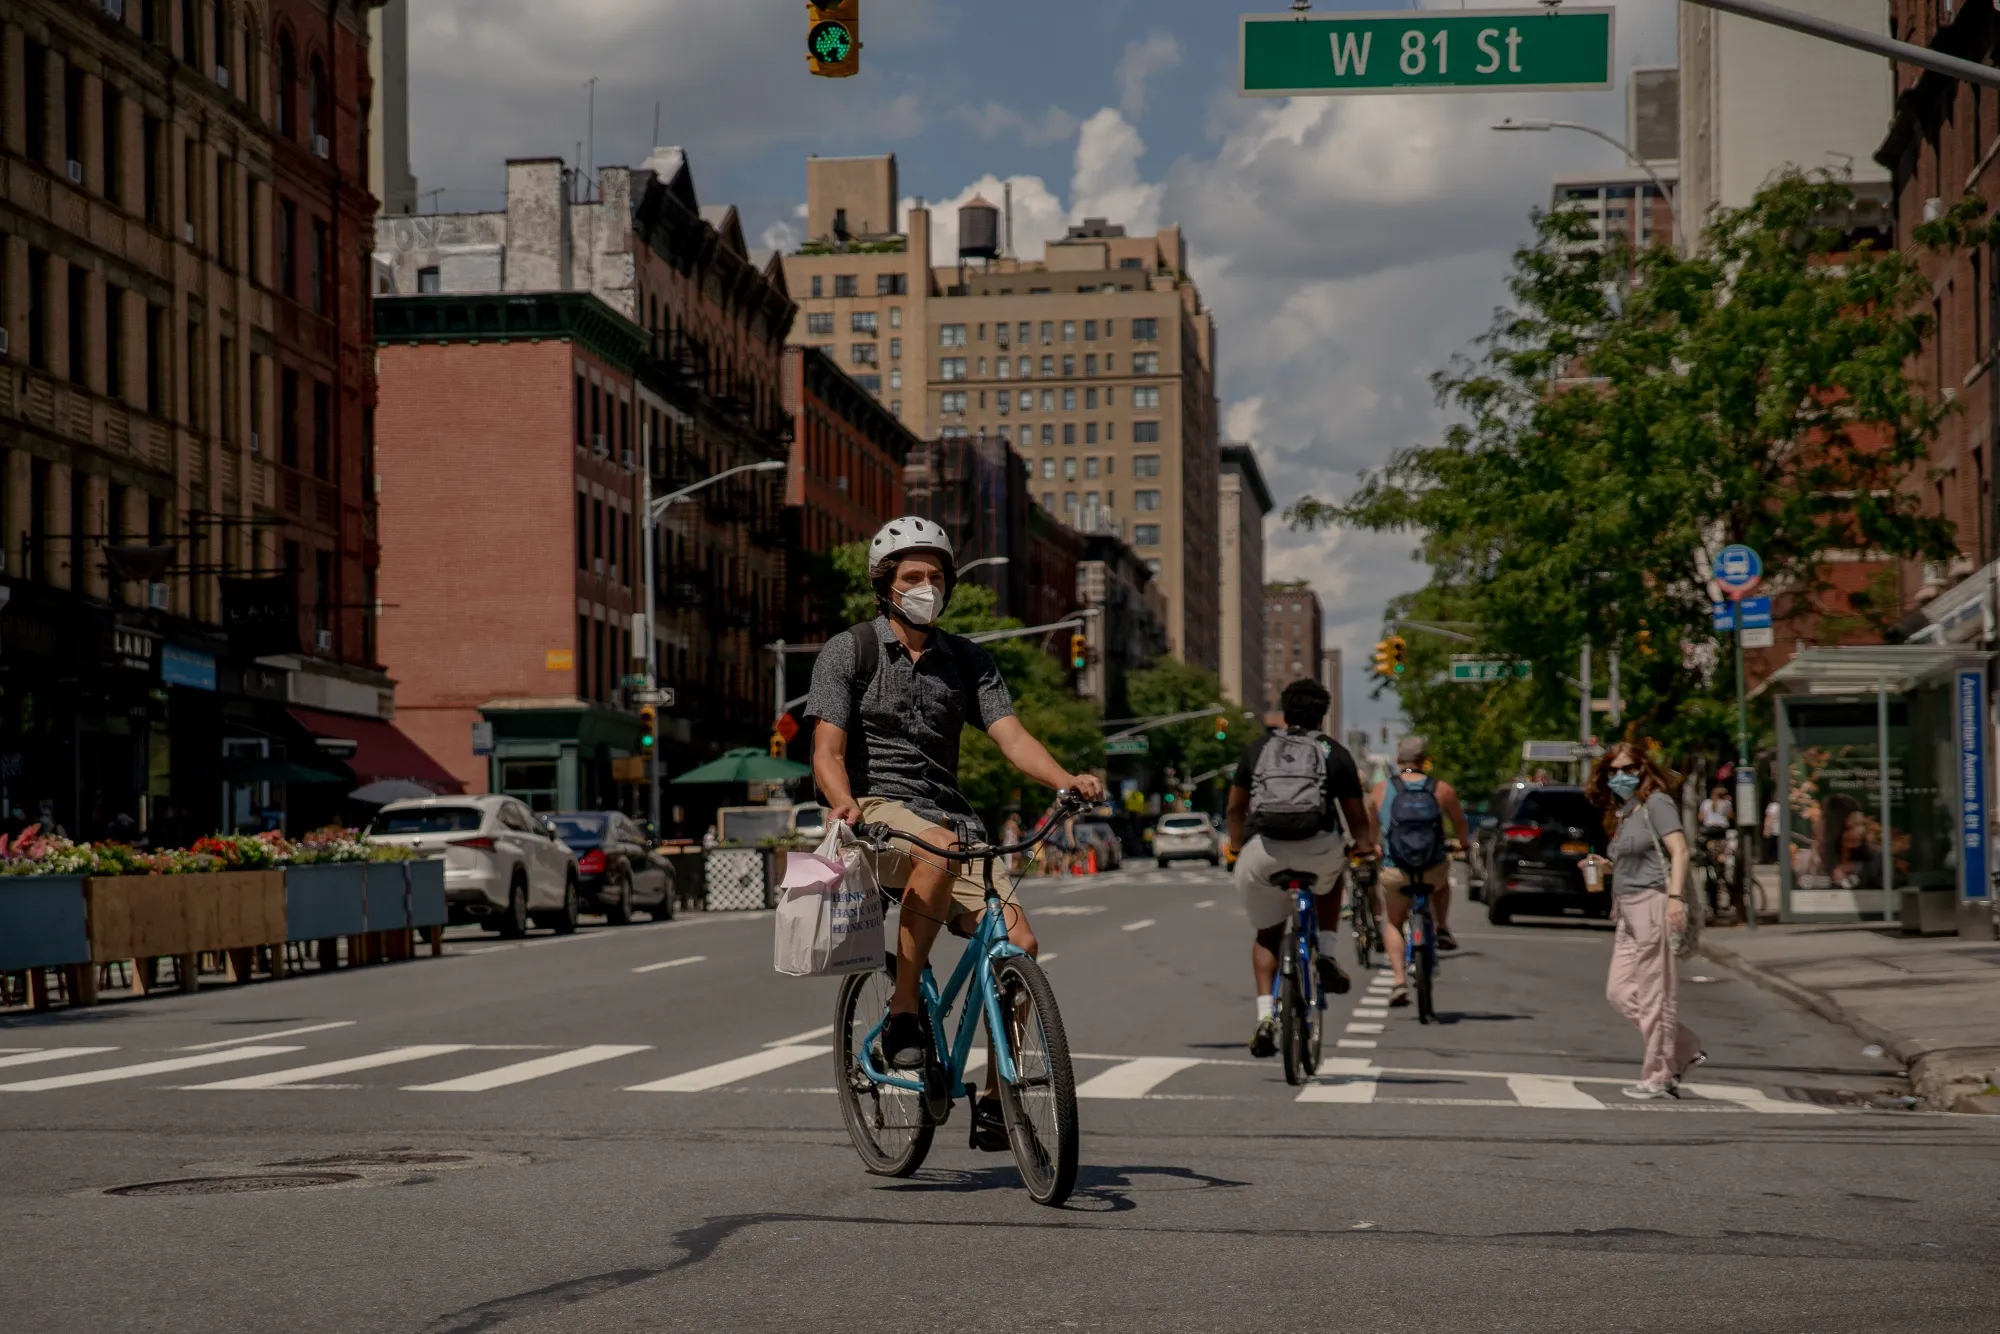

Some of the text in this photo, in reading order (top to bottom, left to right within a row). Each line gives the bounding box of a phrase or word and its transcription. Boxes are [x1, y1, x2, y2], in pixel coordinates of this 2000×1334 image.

[1329, 26, 1523, 77] W 81 St
[114, 630, 153, 659] LAND
[1962, 677, 1977, 751] Amsterdam
[1963, 752, 1979, 801] Avenue
[832, 891, 865, 903] HANK
[832, 907, 865, 918] HANK
[832, 917, 881, 933] HANK YOU
